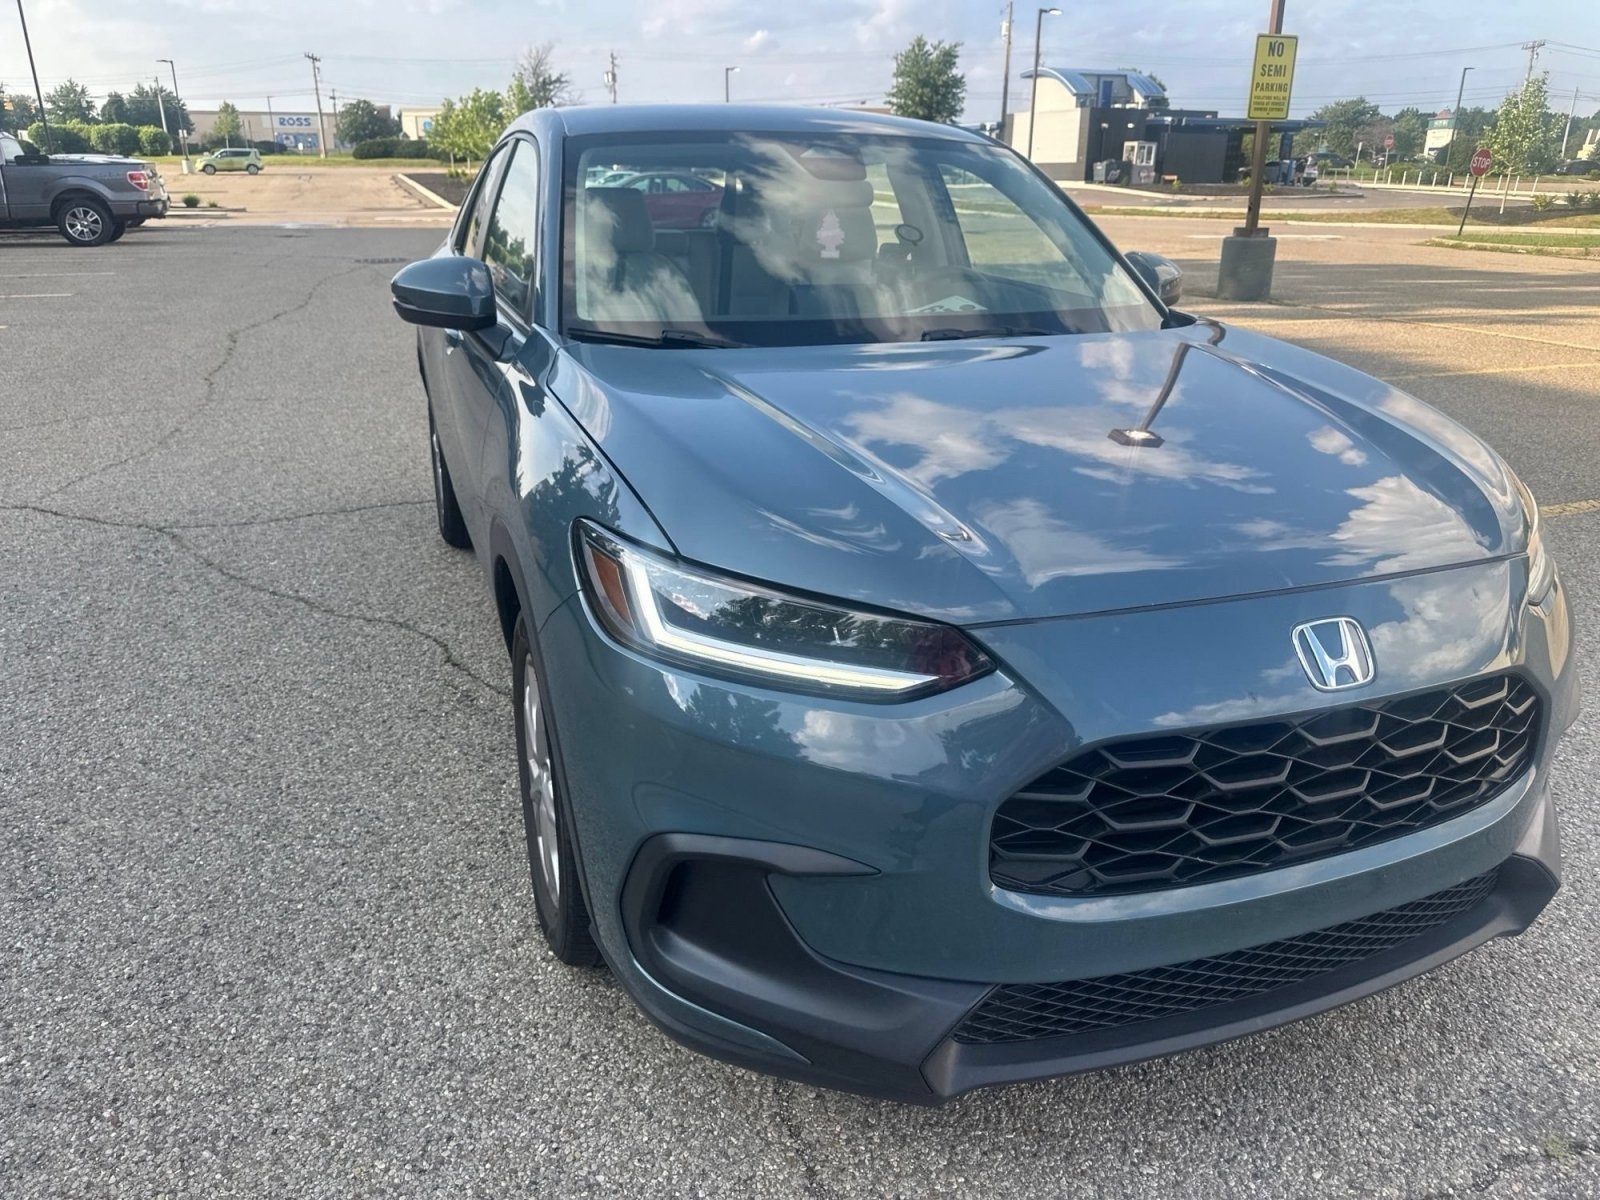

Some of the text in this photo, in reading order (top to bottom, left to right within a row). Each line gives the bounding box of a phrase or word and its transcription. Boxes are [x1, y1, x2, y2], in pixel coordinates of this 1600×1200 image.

[1267, 41, 1284, 57] NO
[1260, 64, 1287, 77] SEMI
[1254, 82, 1288, 93] PARKING
[279, 117, 312, 127] ROSS
[1472, 156, 1490, 169] STOP
